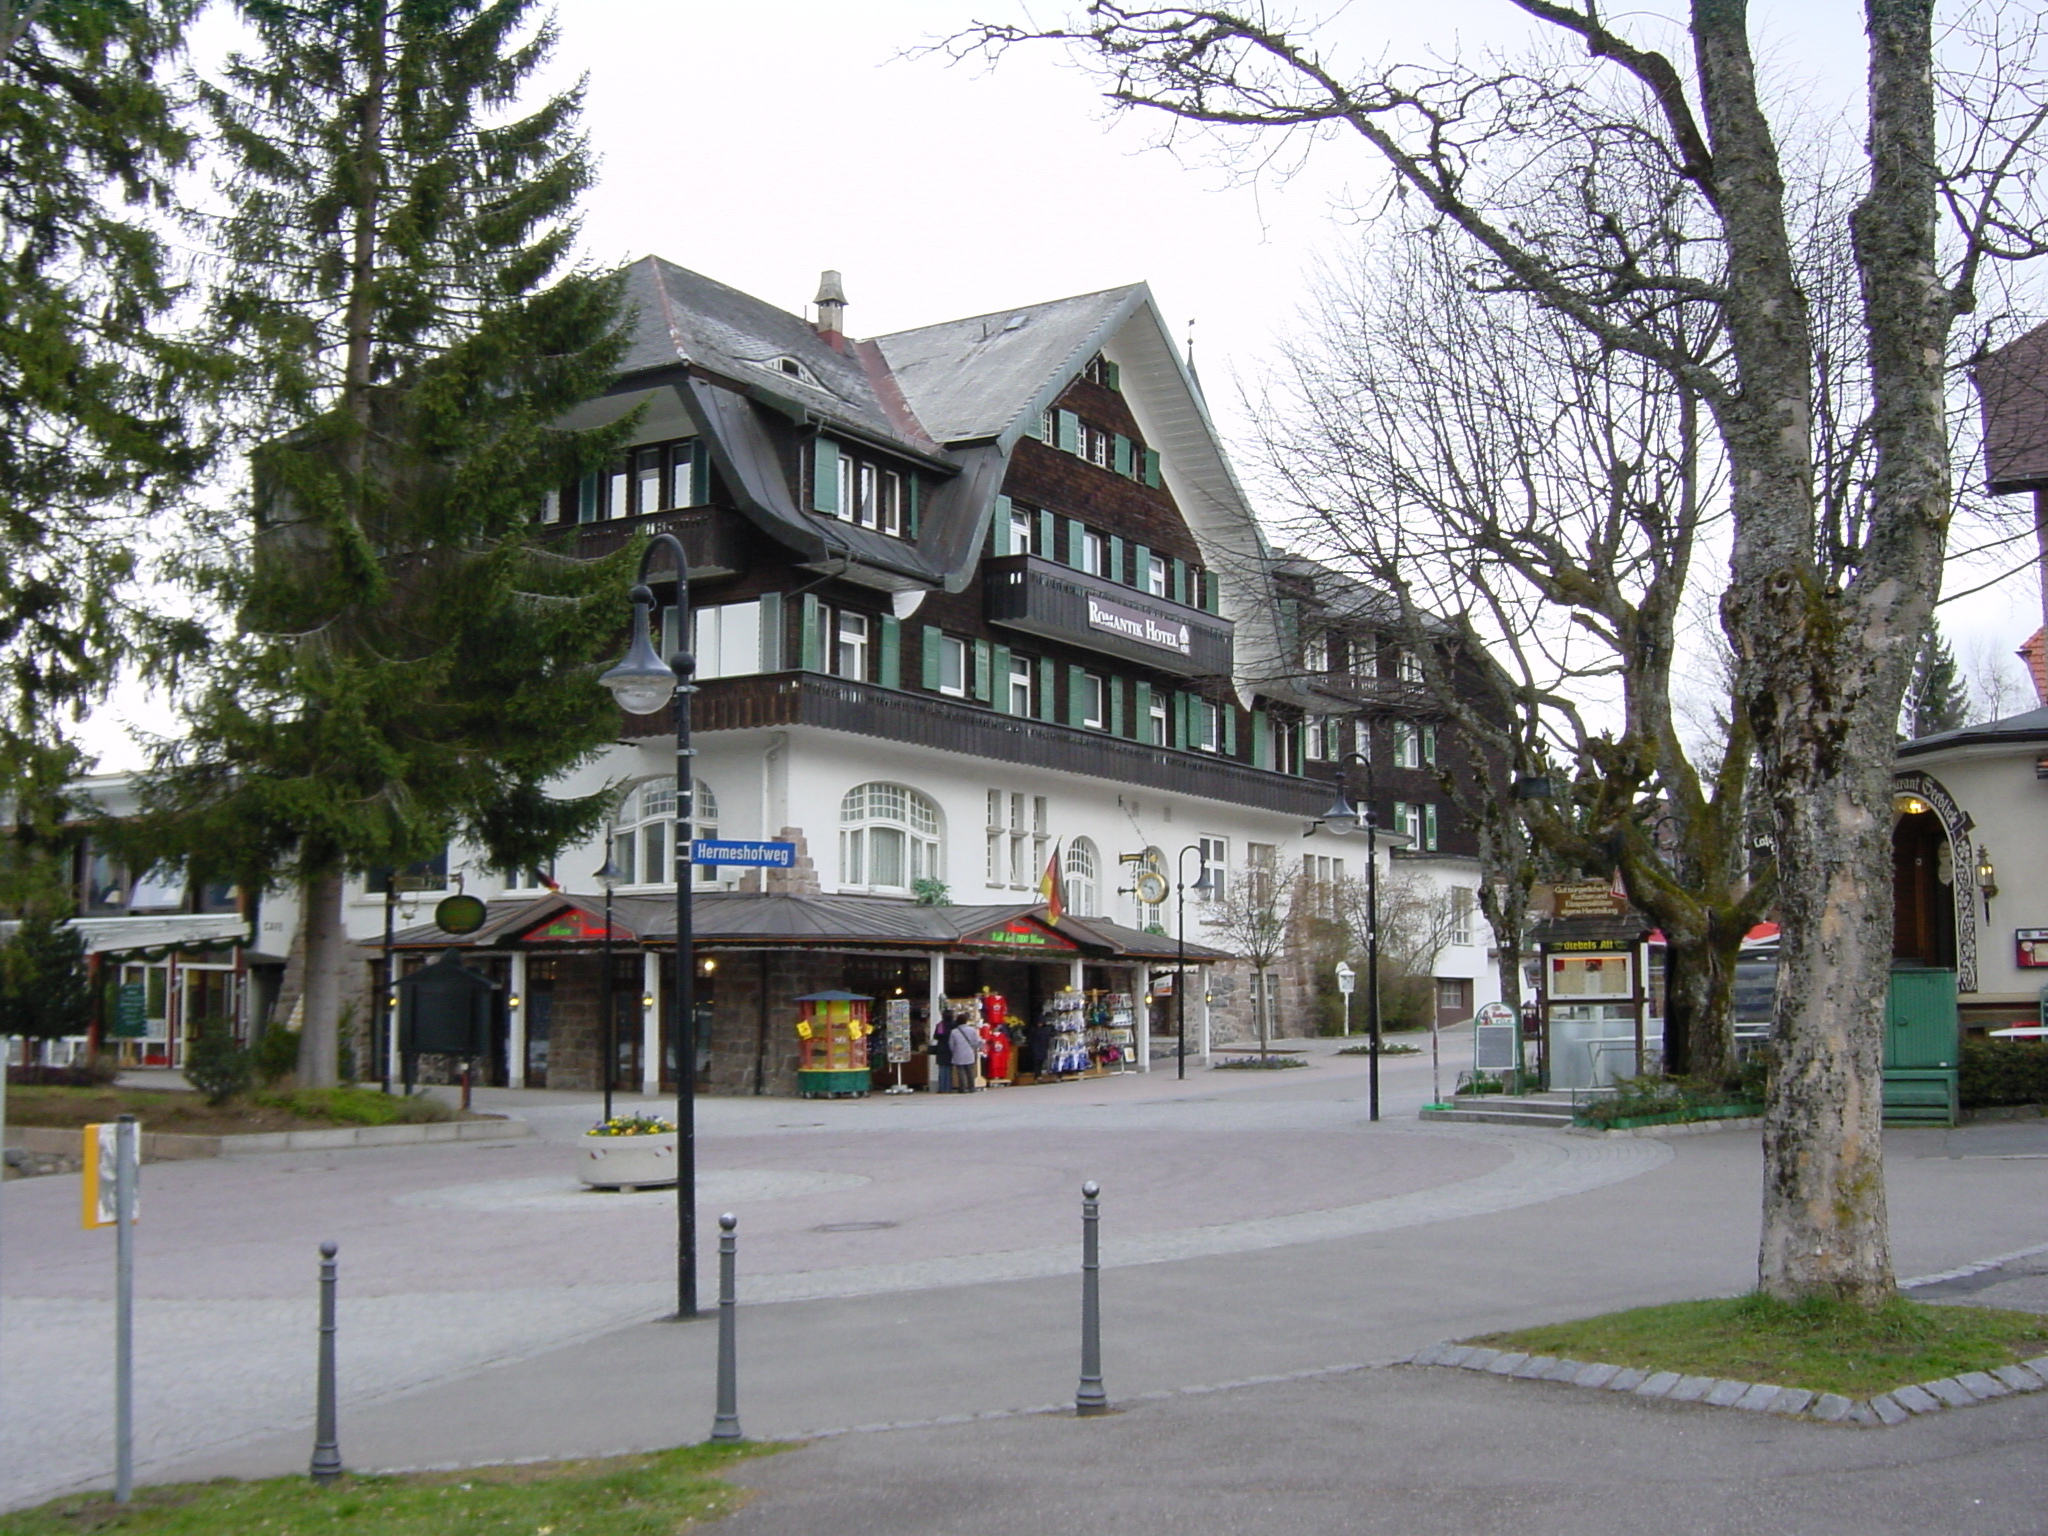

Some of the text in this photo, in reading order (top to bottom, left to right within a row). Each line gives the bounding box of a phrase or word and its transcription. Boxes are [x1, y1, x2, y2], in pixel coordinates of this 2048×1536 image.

[1088, 600, 1179, 647] ROMANTIK HOTEL
[697, 842, 789, 866] Hermeshofweg
